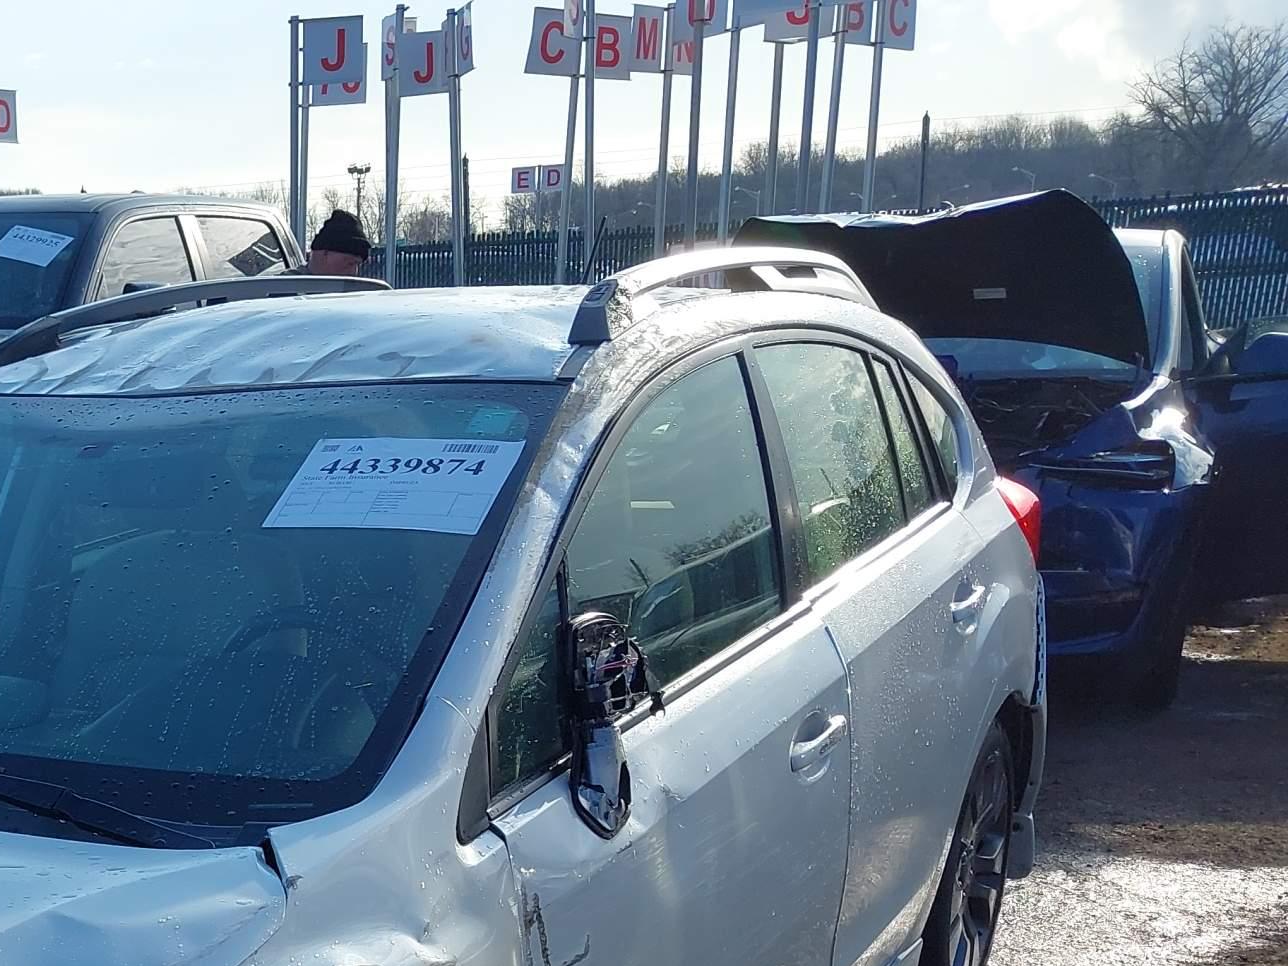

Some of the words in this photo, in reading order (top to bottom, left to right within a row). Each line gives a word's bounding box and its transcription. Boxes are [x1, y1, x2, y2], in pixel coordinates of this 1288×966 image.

[320, 28, 346, 72] J
[540, 20, 565, 64] C
[595, 26, 620, 68] B
[636, 16, 659, 60] M
[413, 42, 434, 84] J
[517, 170, 530, 189] E
[546, 169, 561, 187] D
[320, 458, 486, 476] 44339874
